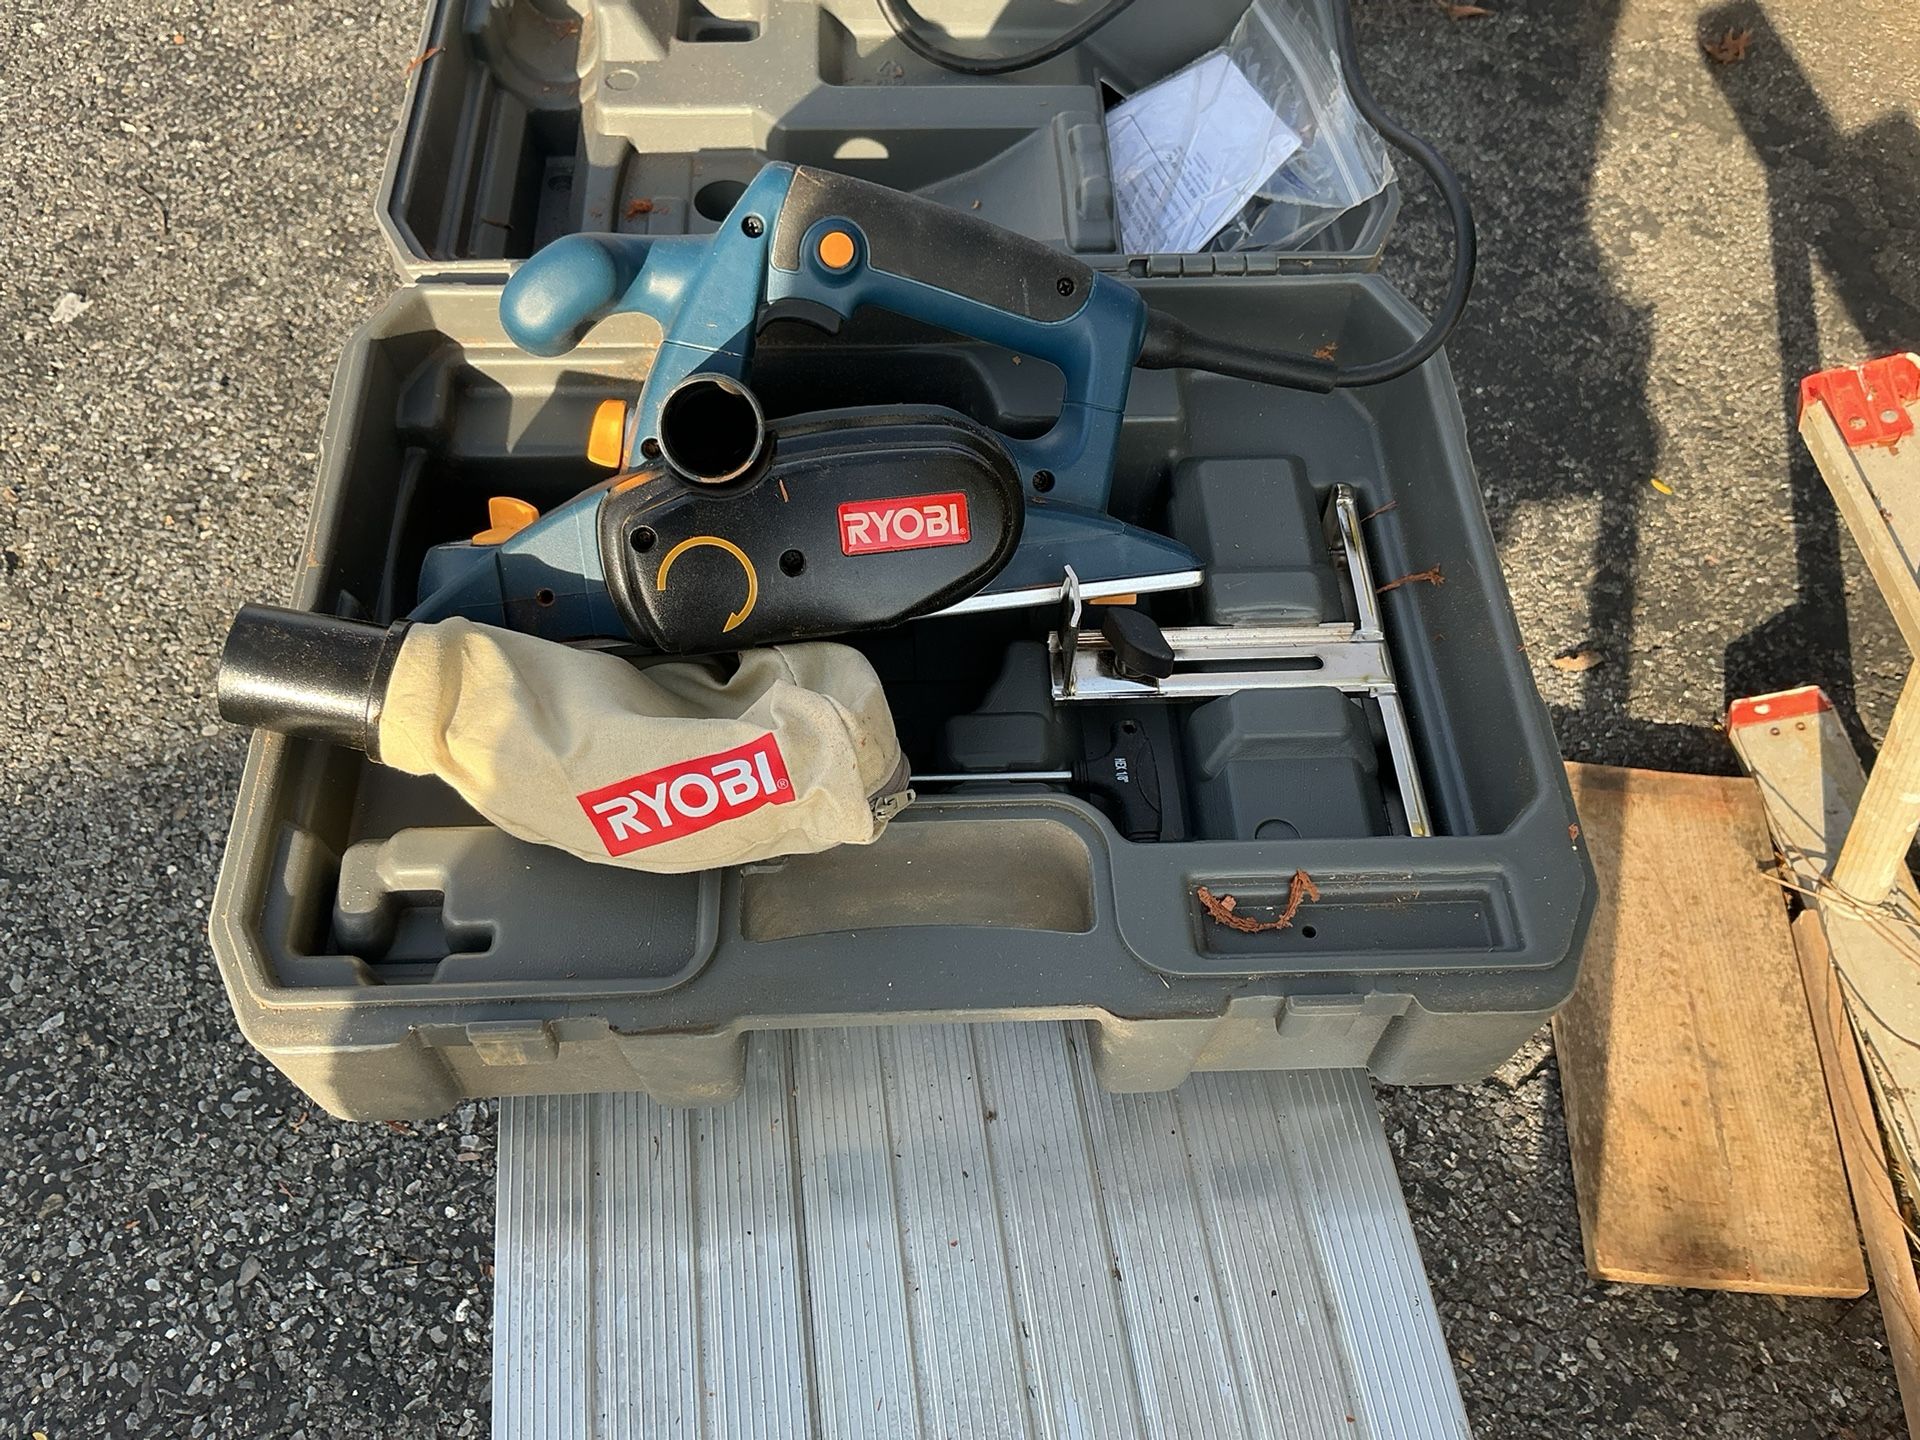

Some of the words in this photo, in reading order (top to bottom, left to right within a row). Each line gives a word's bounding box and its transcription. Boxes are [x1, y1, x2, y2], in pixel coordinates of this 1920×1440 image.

[843, 503, 960, 545] RYOBI
[1114, 758, 1127, 771] HEX
[592, 751, 778, 841] RYOBI
